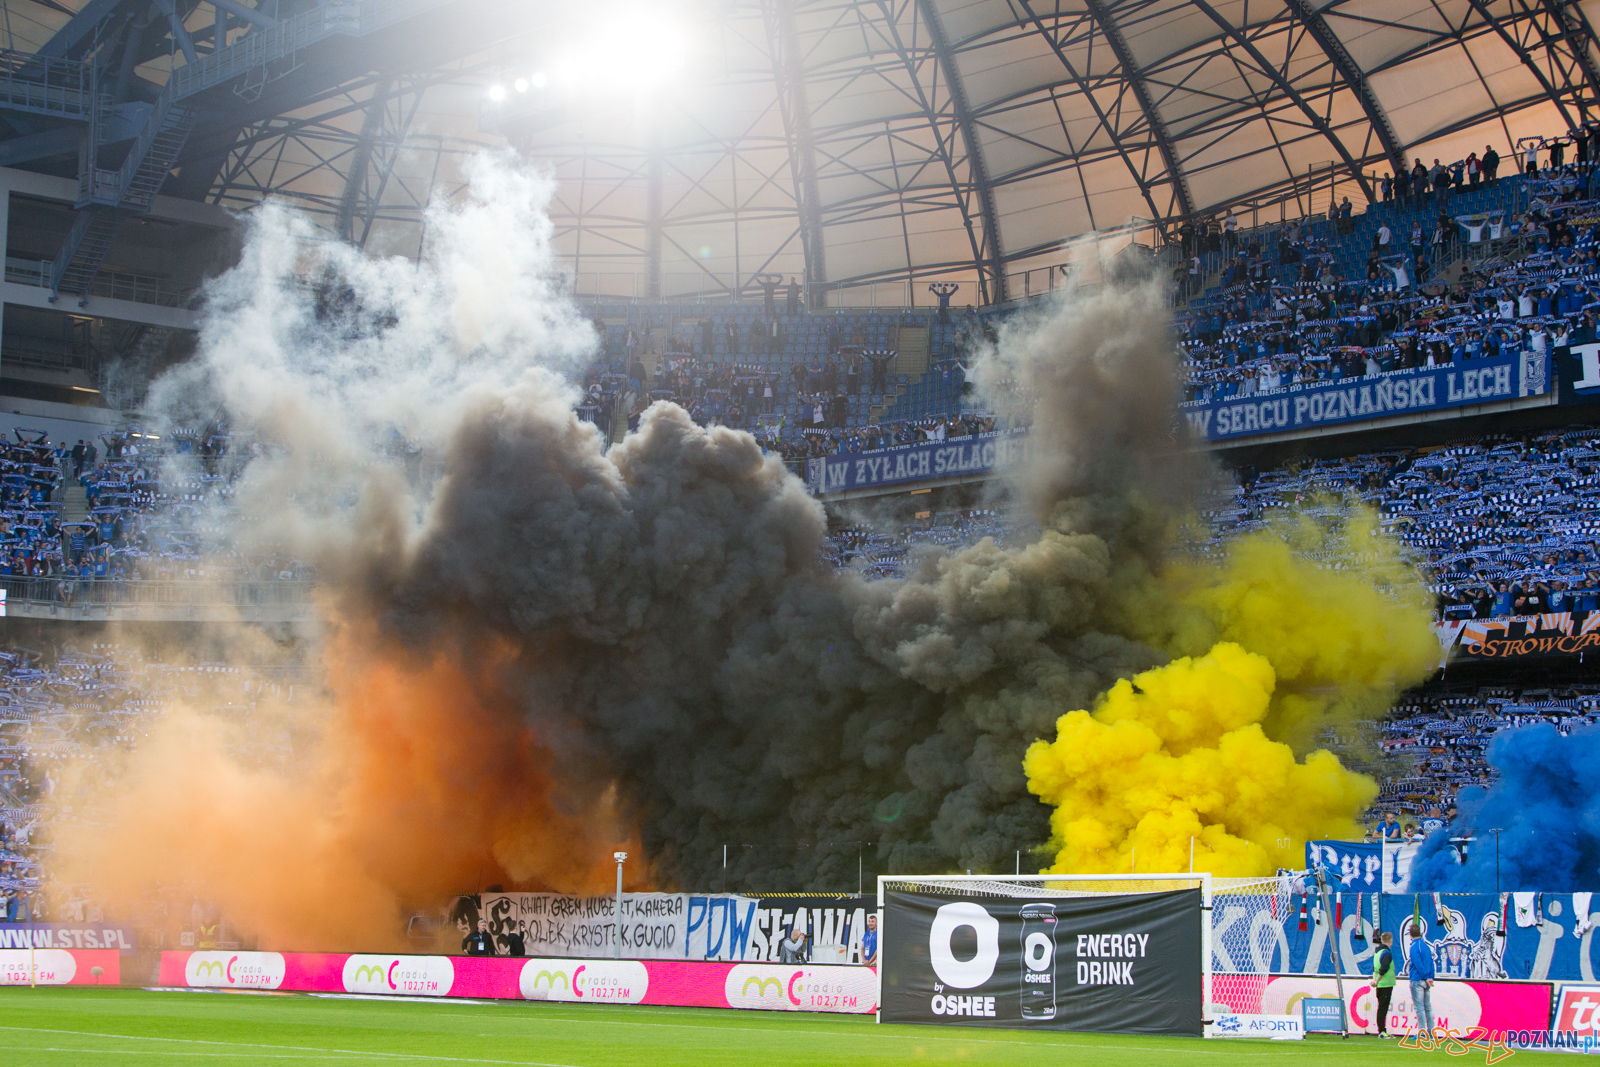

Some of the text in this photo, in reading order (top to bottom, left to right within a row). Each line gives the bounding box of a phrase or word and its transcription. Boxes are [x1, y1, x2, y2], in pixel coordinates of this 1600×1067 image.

[1224, 392, 1251, 402] NASZA
[1290, 383, 1302, 392] DO
[1305, 379, 1334, 389] LECHA
[1337, 375, 1358, 385] JEST
[1419, 361, 1455, 372] WIELKA
[1186, 409, 1212, 438] W
[1217, 399, 1290, 435] SERCU
[1294, 376, 1436, 424] POZNAŃSKI
[1447, 364, 1512, 403] LECH
[948, 434, 973, 443] HONOR
[978, 430, 1003, 439] RAZEM
[827, 461, 849, 487] W
[685, 896, 757, 960] PDW
[181, 934, 194, 943] 21
[634, 923, 676, 949] GUCIO
[1076, 933, 1149, 958] ENERGY
[238, 965, 262, 974] radio
[401, 970, 428, 979] radio
[1076, 961, 1135, 985] DRINK
[40, 972, 55, 981] FM
[240, 975, 271, 985] 102,7 FM
[587, 976, 618, 986] radio
[1025, 974, 1051, 983] OSHEE
[403, 981, 438, 991] 102,7 FM
[807, 983, 843, 993] radio
[933, 982, 944, 993] by
[590, 987, 630, 999] 102,7 FM
[810, 995, 857, 1008] 102,7 FM
[931, 995, 996, 1017] OSHEE
[1306, 1005, 1340, 1015] AZTORIN
[1249, 1019, 1299, 1033] AFORTI
